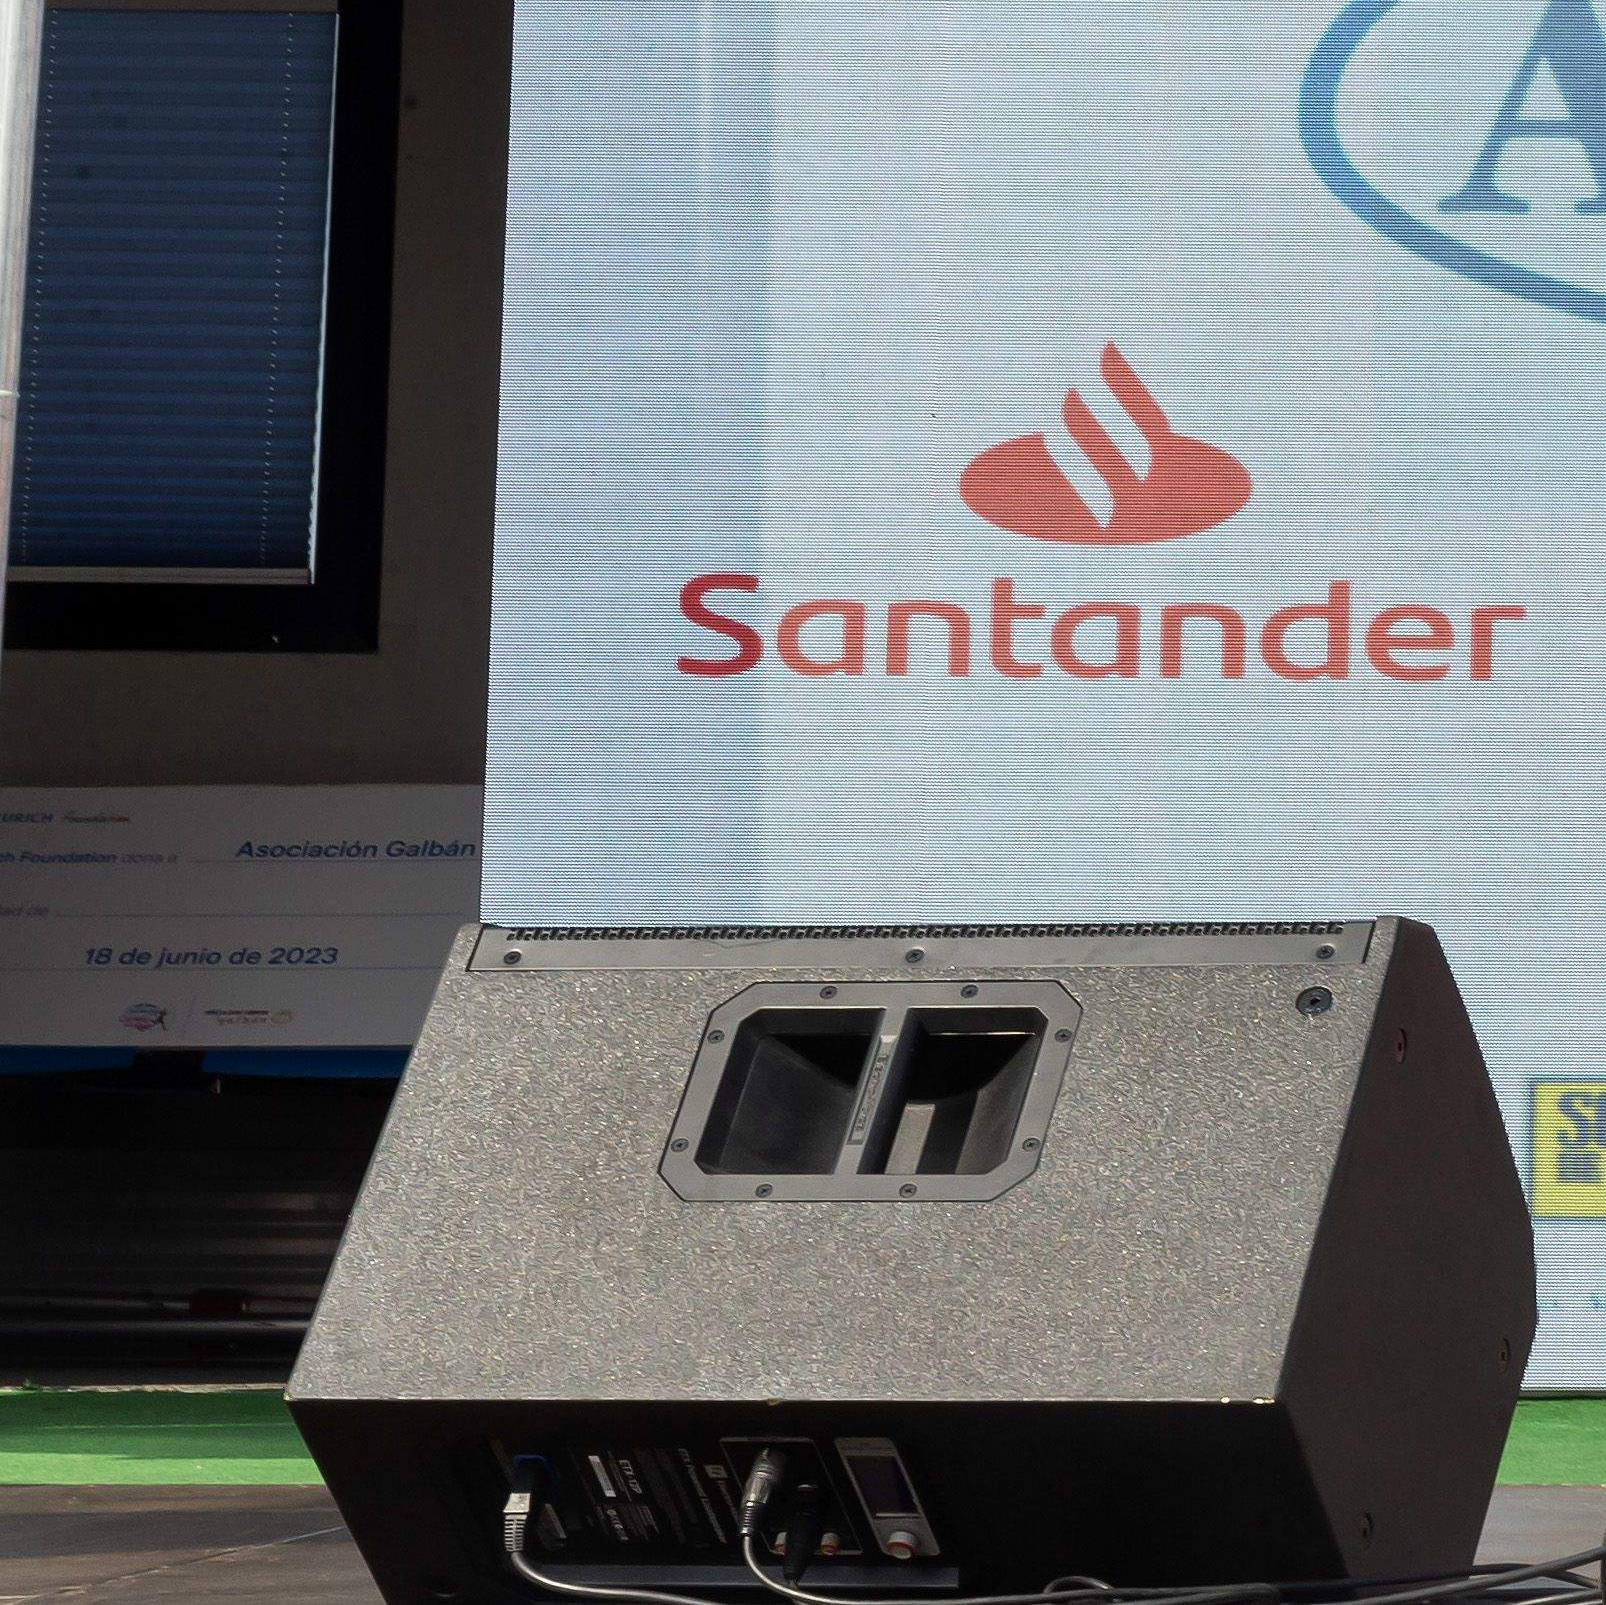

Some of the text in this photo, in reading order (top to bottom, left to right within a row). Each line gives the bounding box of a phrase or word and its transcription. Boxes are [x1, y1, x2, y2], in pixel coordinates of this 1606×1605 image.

[676, 573, 1526, 682] Santander
[235, 840, 477, 859] Asociación Galbán
[85, 946, 339, 969] 18 de junio de 2023
